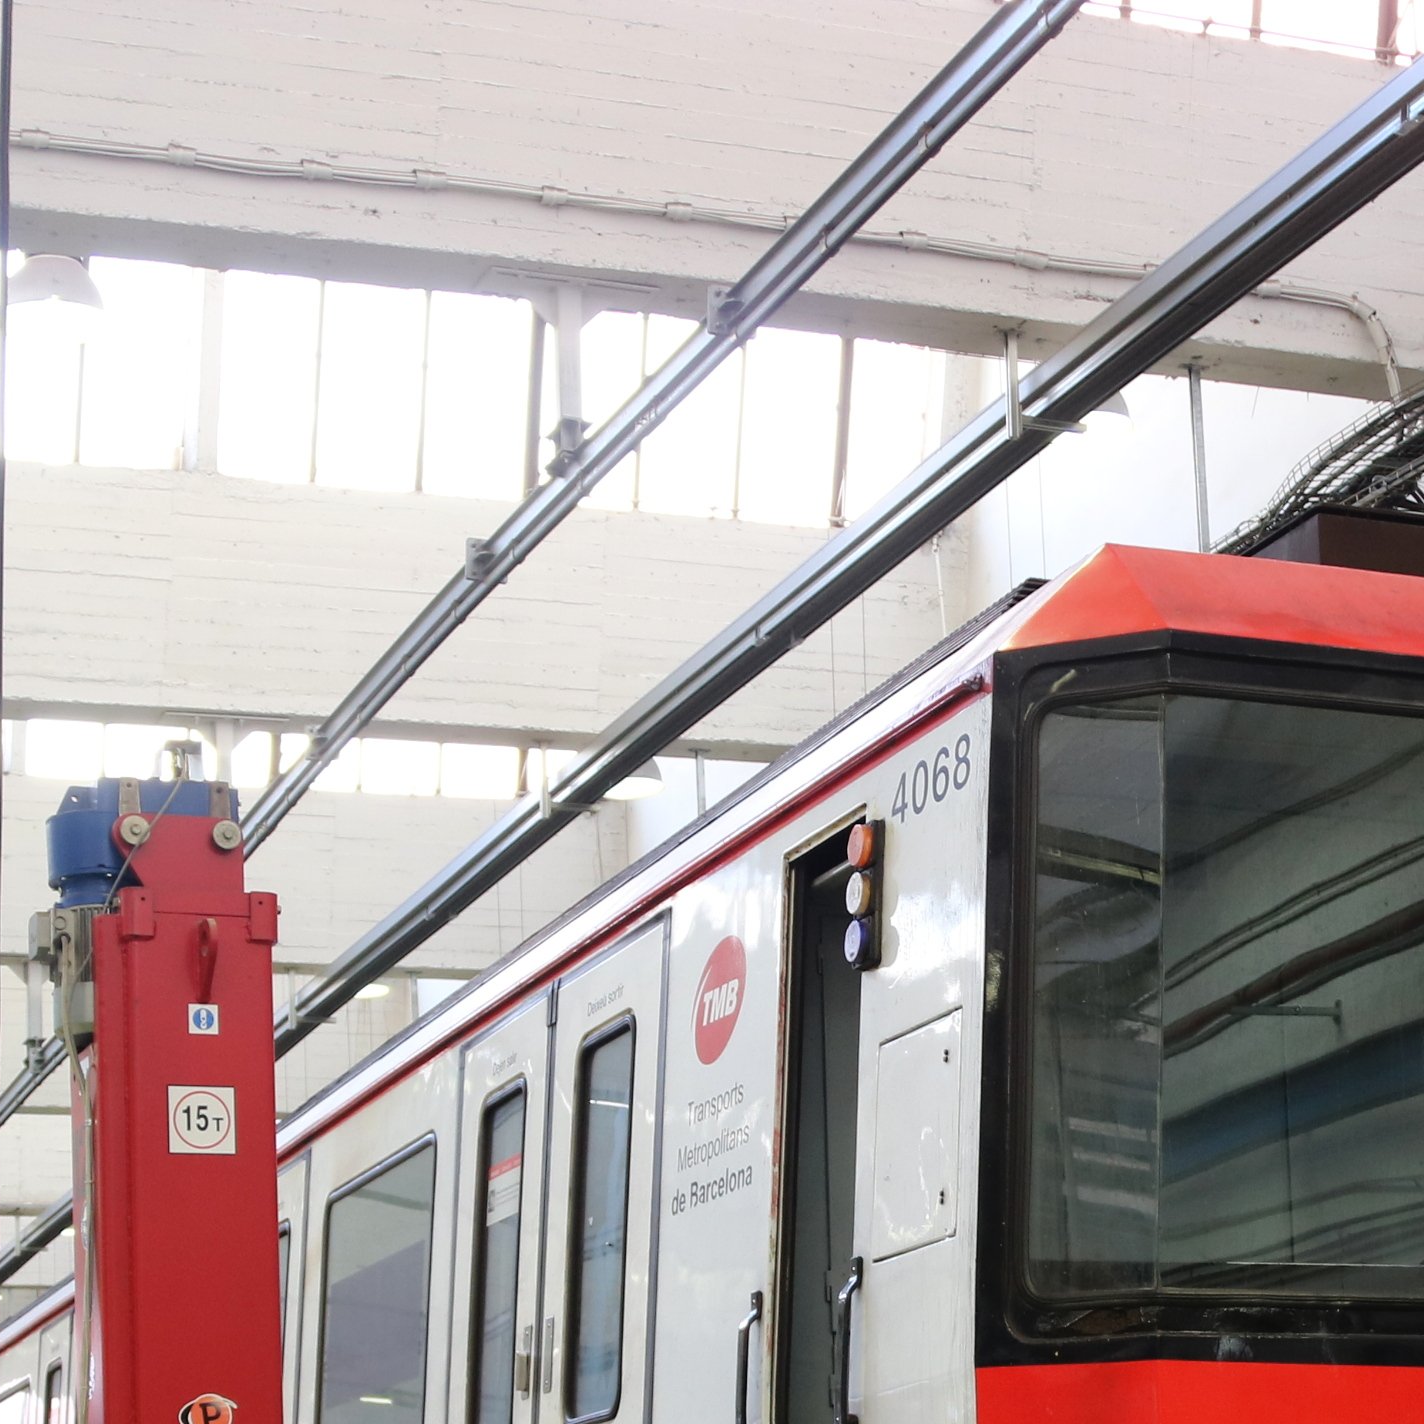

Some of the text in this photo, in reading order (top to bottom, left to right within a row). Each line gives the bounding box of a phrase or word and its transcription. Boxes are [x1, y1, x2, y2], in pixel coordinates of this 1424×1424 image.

[892, 733, 971, 824] 4068
[702, 977, 740, 1027] TMB
[688, 1082, 744, 1127] Transports
[677, 1124, 750, 1174] Metropolitans
[671, 1164, 753, 1217] de Barcelona
